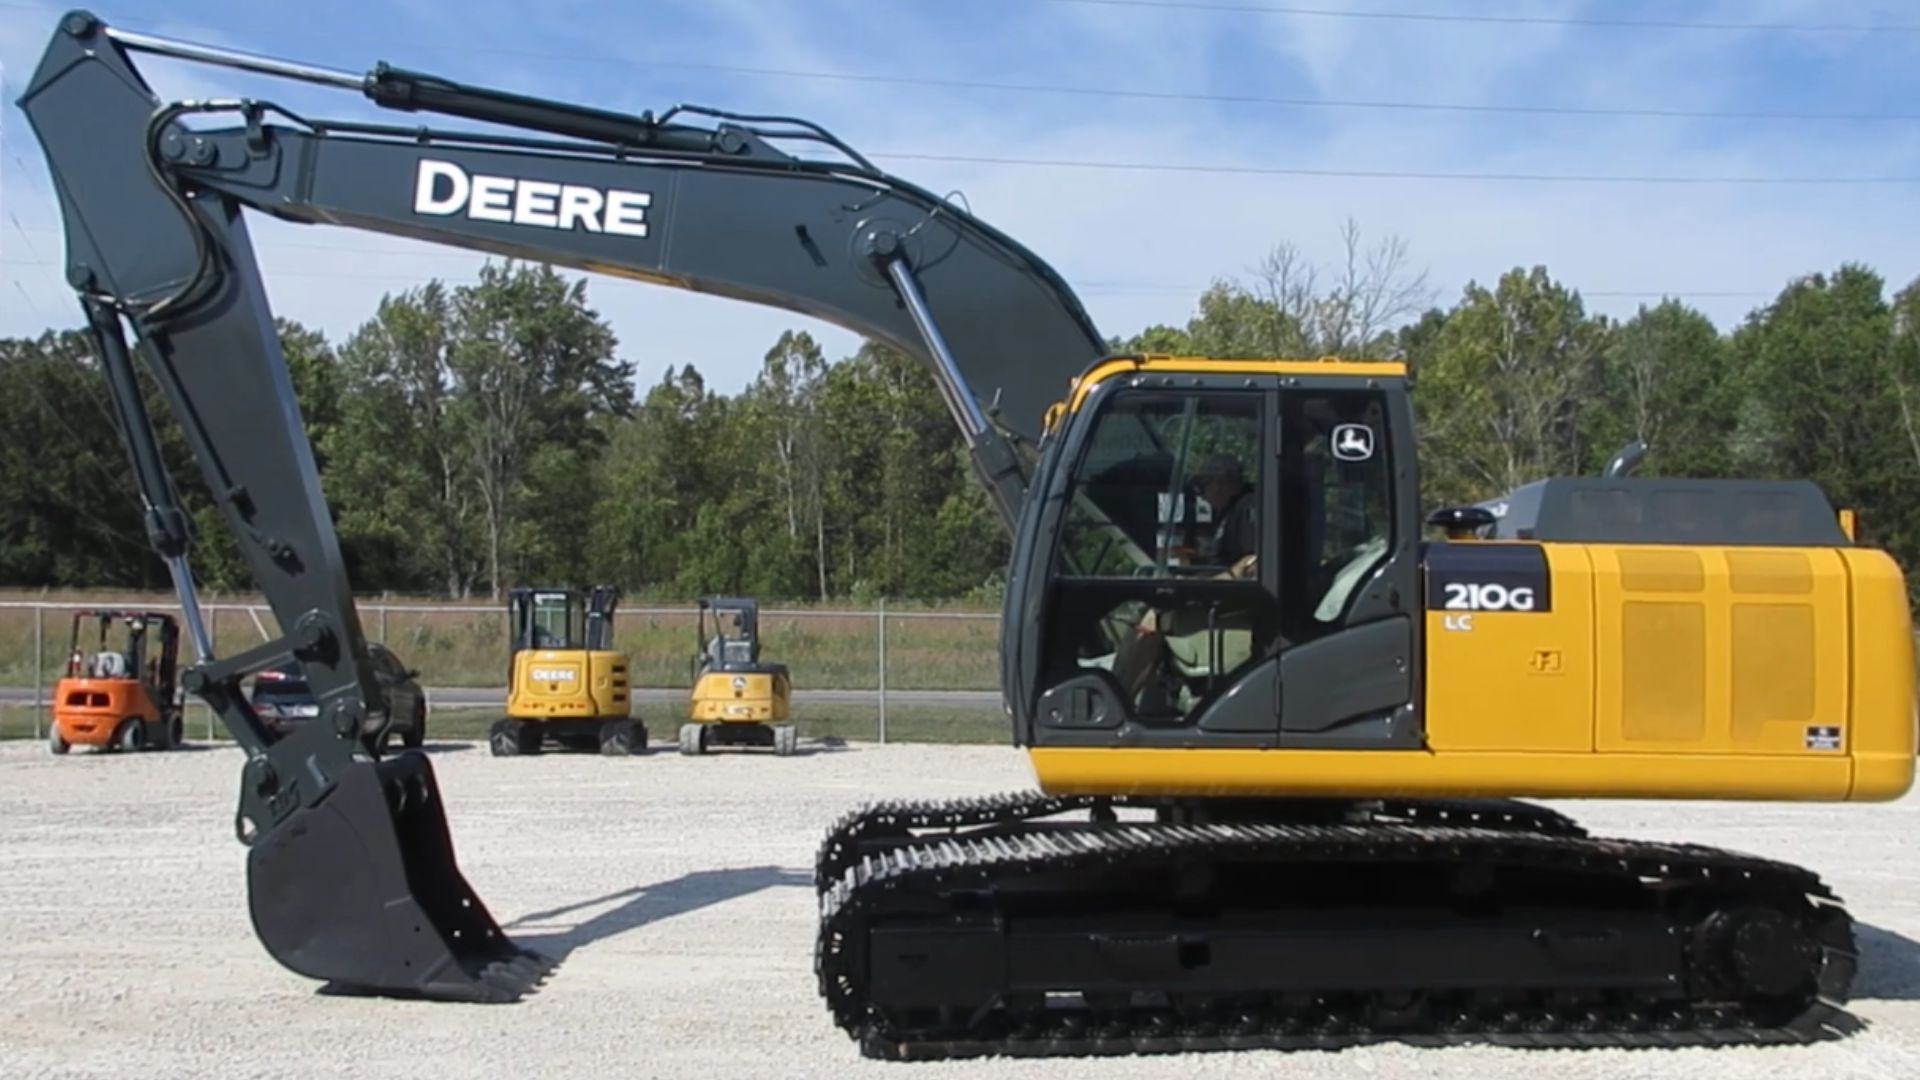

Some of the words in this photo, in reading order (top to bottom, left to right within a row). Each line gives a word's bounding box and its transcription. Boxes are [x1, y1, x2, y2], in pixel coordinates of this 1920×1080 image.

[415, 159, 651, 237] DEERE
[1444, 583, 1533, 610] 210G
[1445, 614, 1472, 630] LC
